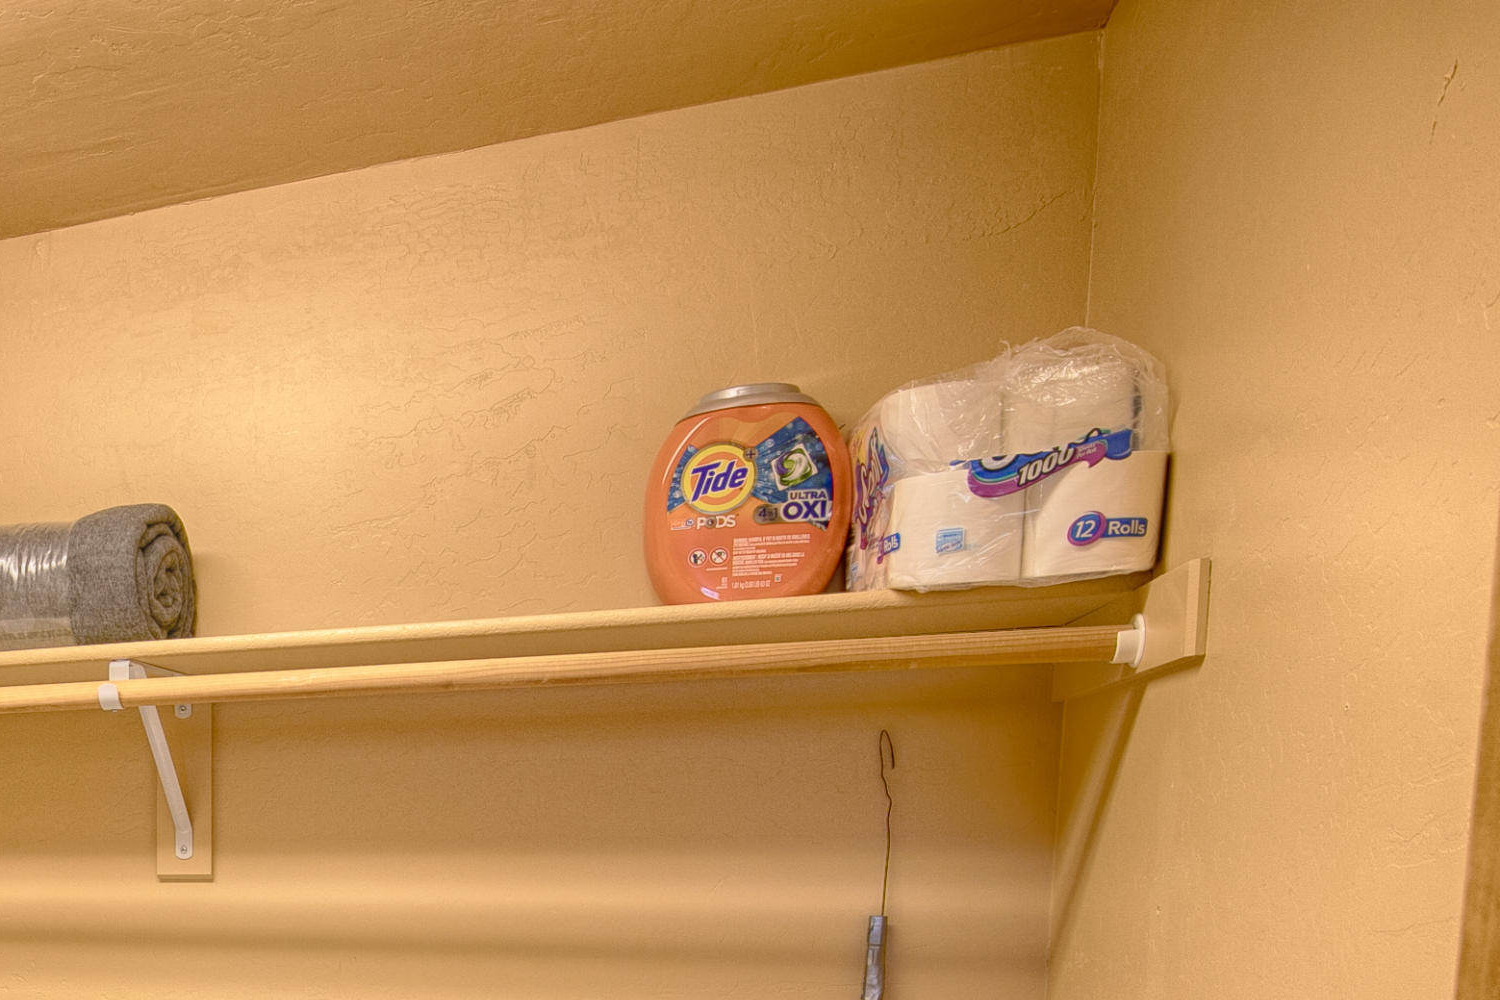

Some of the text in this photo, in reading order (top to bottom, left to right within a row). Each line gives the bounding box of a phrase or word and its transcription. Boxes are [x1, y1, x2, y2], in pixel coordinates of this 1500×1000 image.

[1018, 447, 1074, 485] 1000
[691, 459, 748, 502] Tide
[789, 490, 827, 500] ULTRA
[783, 500, 827, 520] OXI
[1075, 519, 1097, 538] 12
[1108, 519, 1146, 536] Rolls
